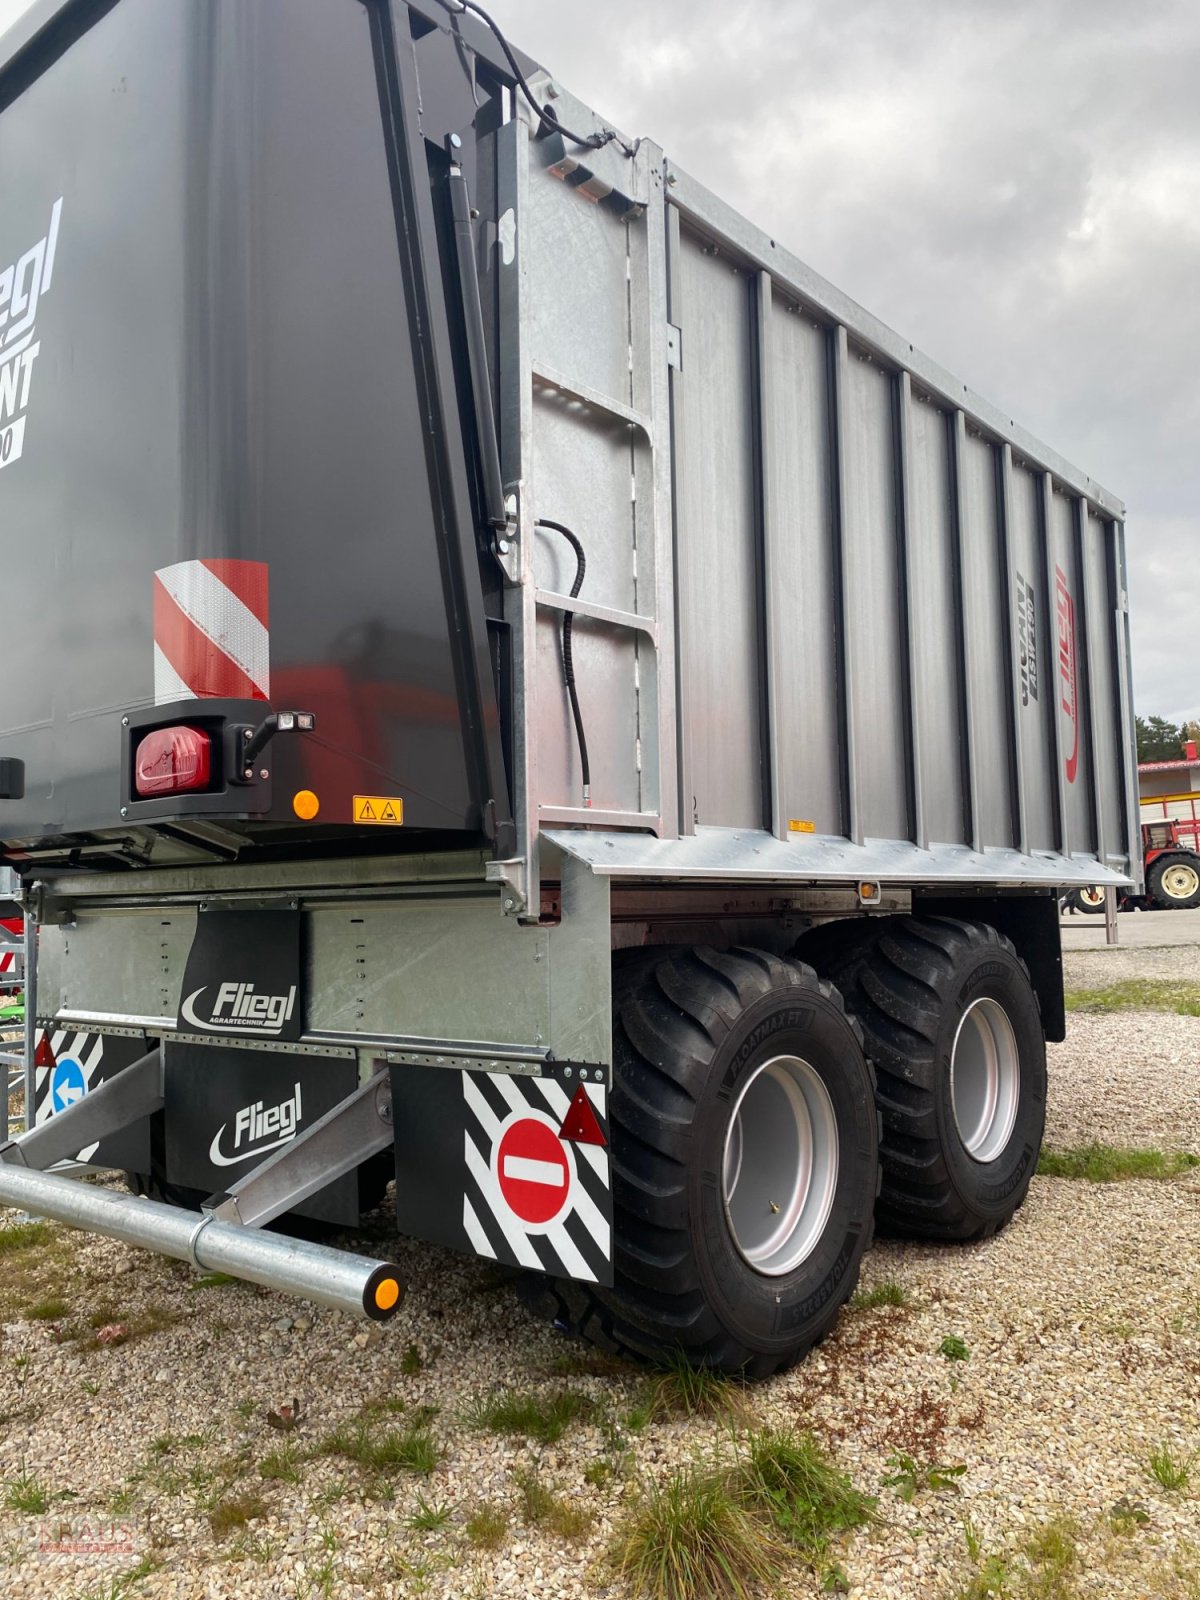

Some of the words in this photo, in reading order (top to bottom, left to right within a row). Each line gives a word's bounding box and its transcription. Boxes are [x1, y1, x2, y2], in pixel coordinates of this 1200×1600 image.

[1026, 598, 1035, 638] 190
[1028, 641, 1037, 689] ASW
[209, 1017, 265, 1026] AGRARTECHNIK
[212, 982, 297, 1027] Fliegl
[731, 1012, 786, 1078] FLOATMAX
[787, 1011, 801, 1024] FT
[234, 1081, 302, 1148] Fliegl
